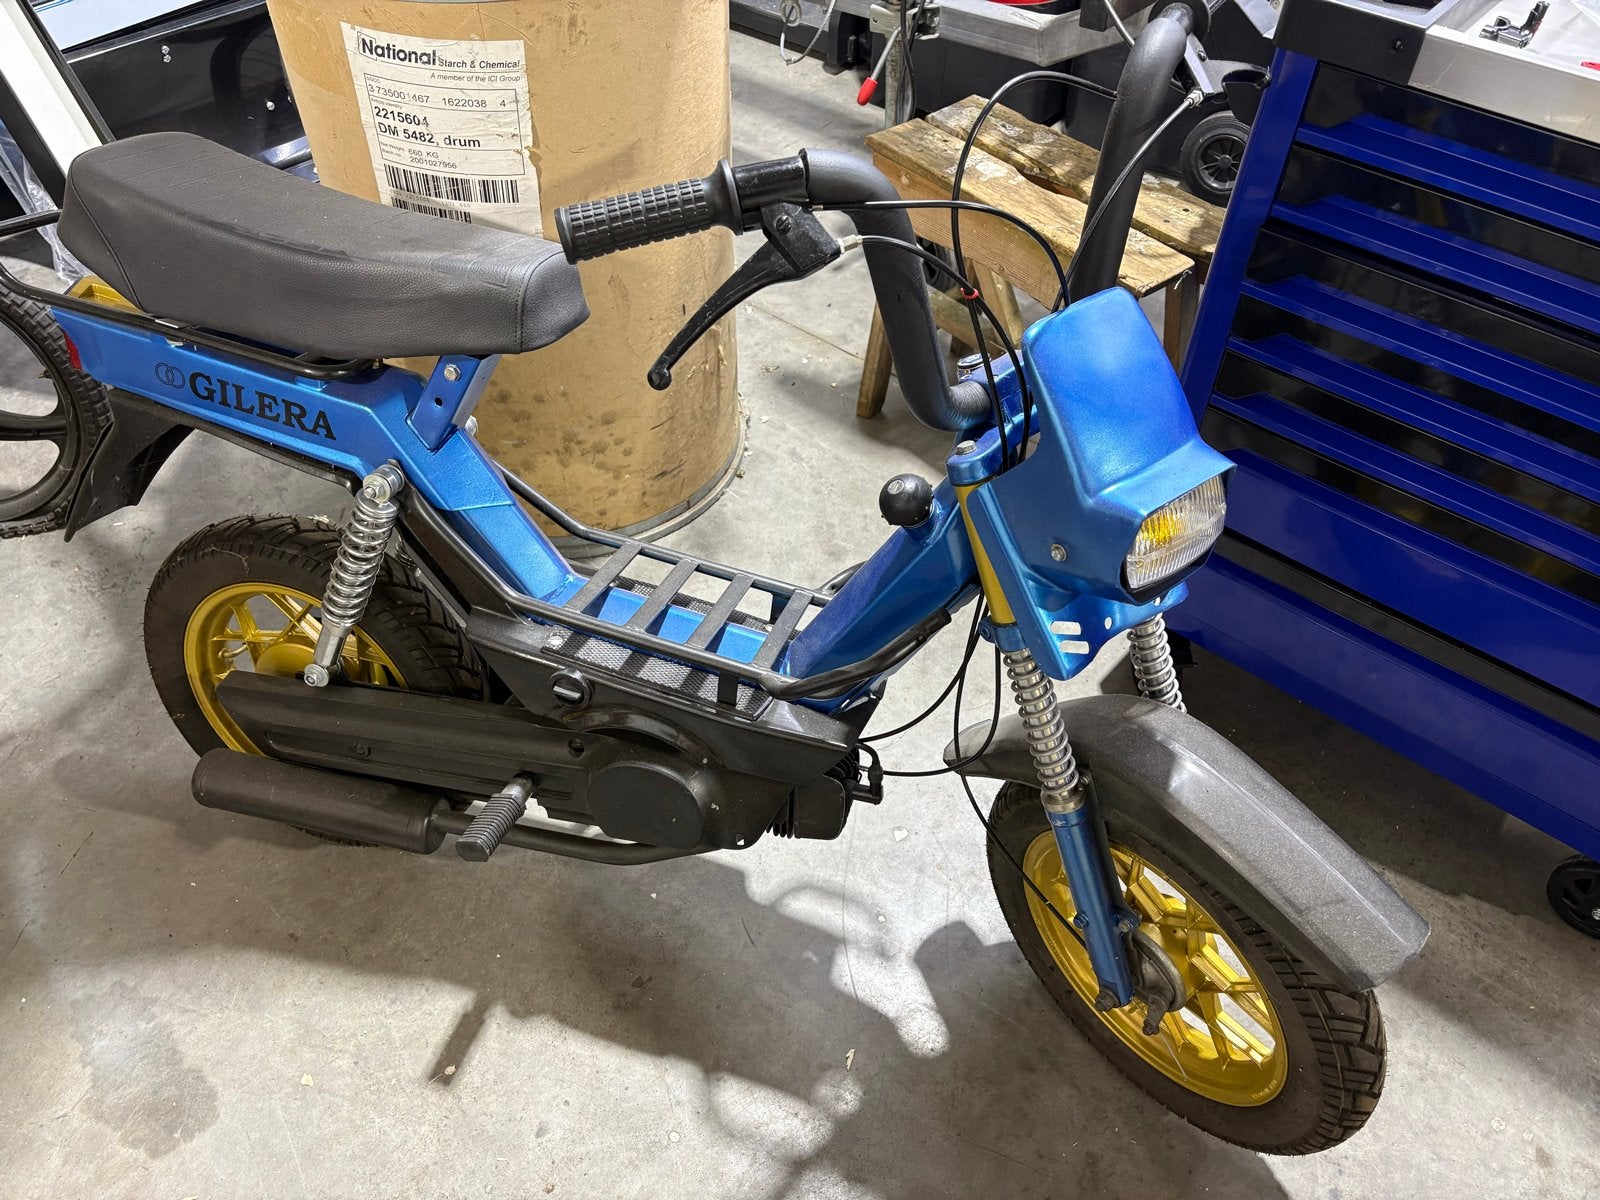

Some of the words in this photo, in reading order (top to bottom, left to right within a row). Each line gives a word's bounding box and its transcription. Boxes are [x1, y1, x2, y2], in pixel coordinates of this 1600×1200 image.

[361, 38, 437, 66] National
[438, 57, 467, 69] Starch
[470, 60, 477, 68] &
[479, 60, 520, 69] Chemical
[437, 73, 465, 81] member
[499, 75, 521, 83] Group
[441, 97, 487, 108] 1622038
[499, 99, 506, 107] 4
[374, 106, 430, 127] 2215604
[377, 122, 400, 137] DM
[403, 127, 440, 146] 5482,
[443, 135, 481, 148] drum
[426, 151, 440, 159] KG
[189, 371, 337, 441] GILERA
